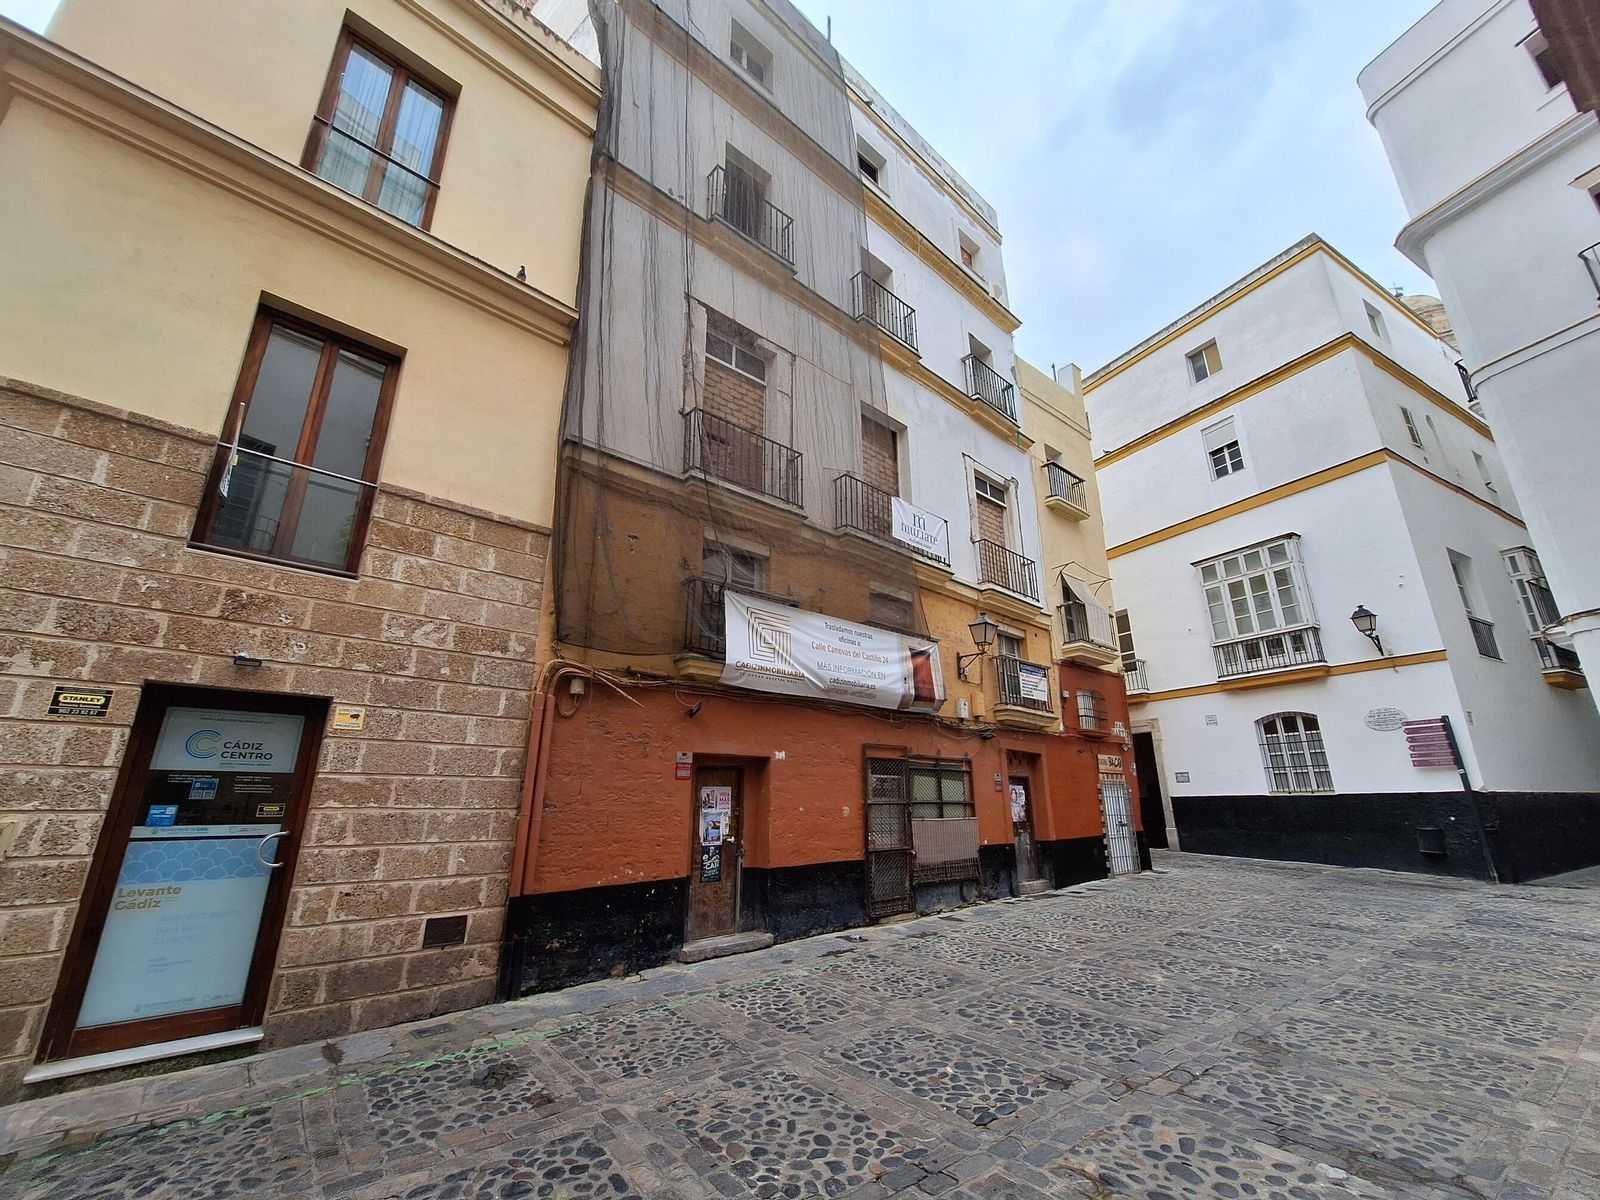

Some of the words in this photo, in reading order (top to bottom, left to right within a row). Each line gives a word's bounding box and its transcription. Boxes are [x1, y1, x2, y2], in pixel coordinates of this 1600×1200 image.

[824, 622, 853, 635] Trasladamos
[854, 630, 873, 640] nuestras
[838, 636, 857, 646] oficinas
[811, 641, 827, 652] Calle
[852, 650, 862, 659] del
[862, 652, 882, 663] Castillo
[882, 656, 889, 664] 24
[877, 671, 886, 680] EN
[223, 740, 264, 751] CÁDIZ
[221, 751, 273, 760] CENTRO
[117, 886, 182, 898] Levante
[114, 898, 161, 911] Cádiz
